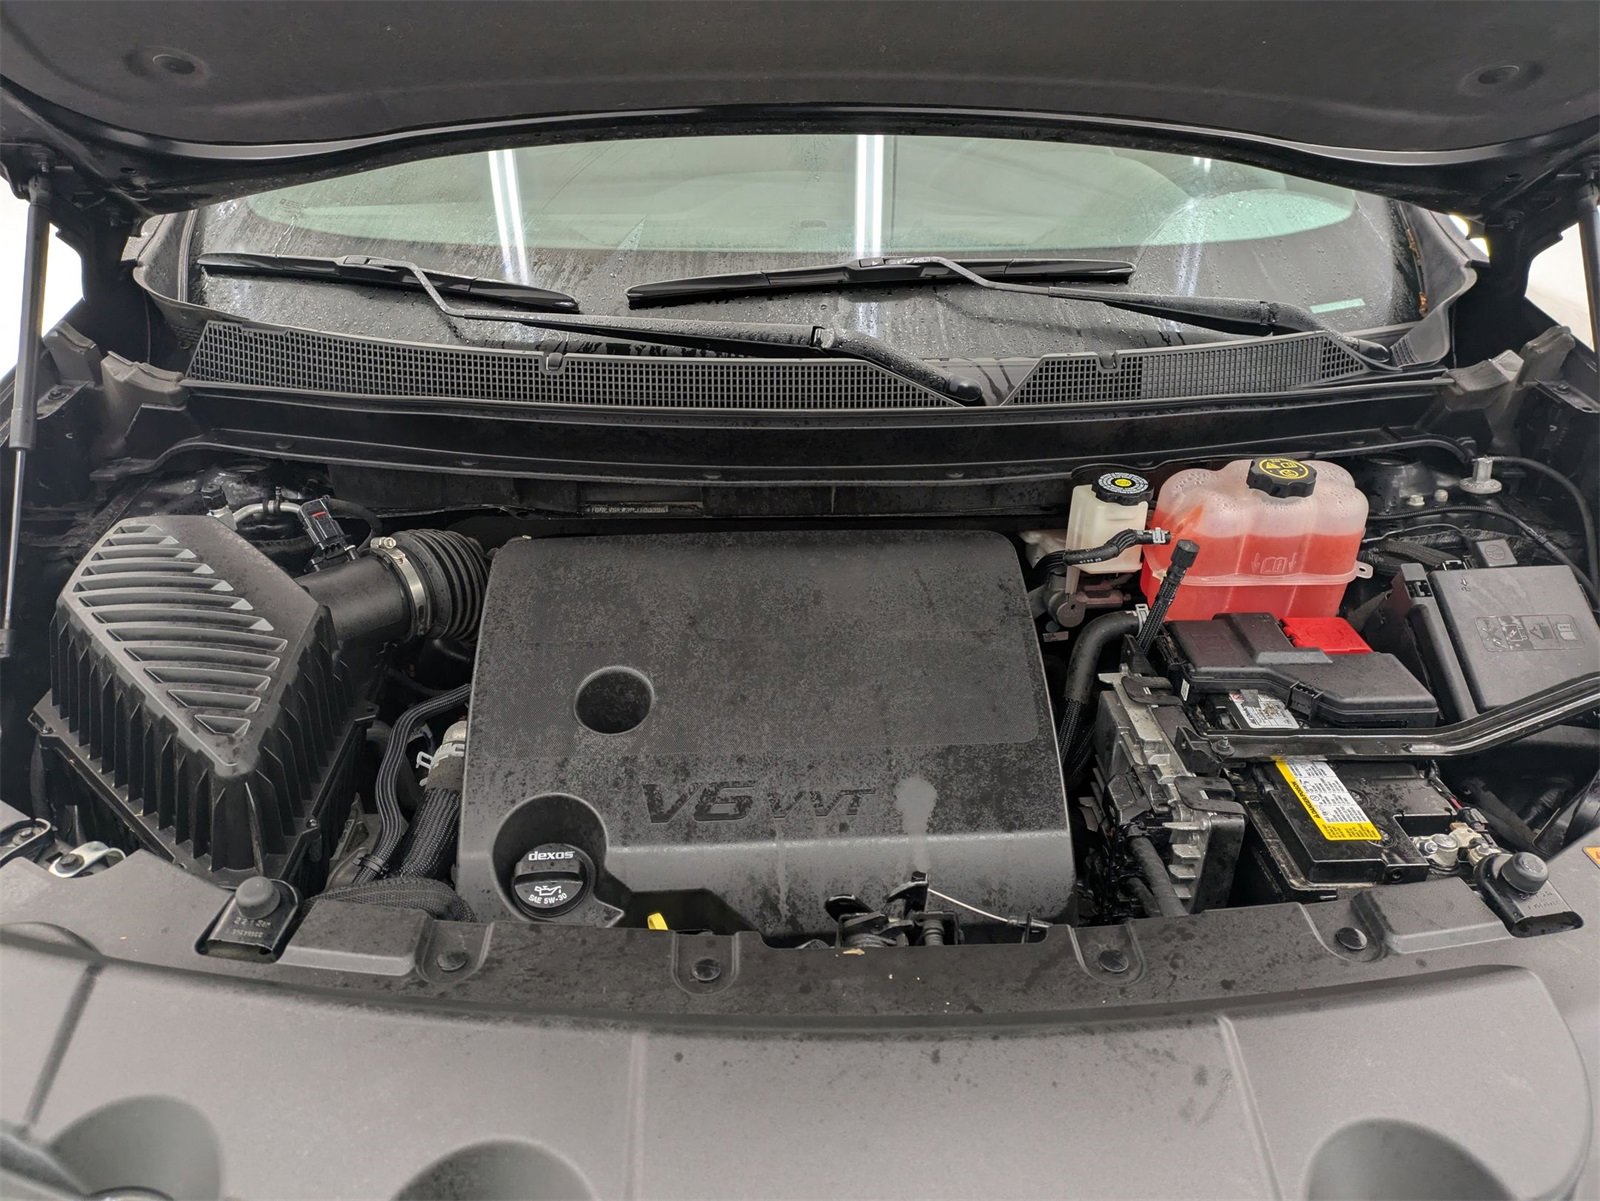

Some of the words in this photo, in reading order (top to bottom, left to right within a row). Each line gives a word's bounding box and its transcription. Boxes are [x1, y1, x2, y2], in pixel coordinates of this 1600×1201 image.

[642, 780, 757, 824] V6
[767, 788, 876, 819] VVT
[528, 850, 575, 861] dexos
[528, 894, 543, 904] SAE
[543, 892, 568, 905] 5W-30
